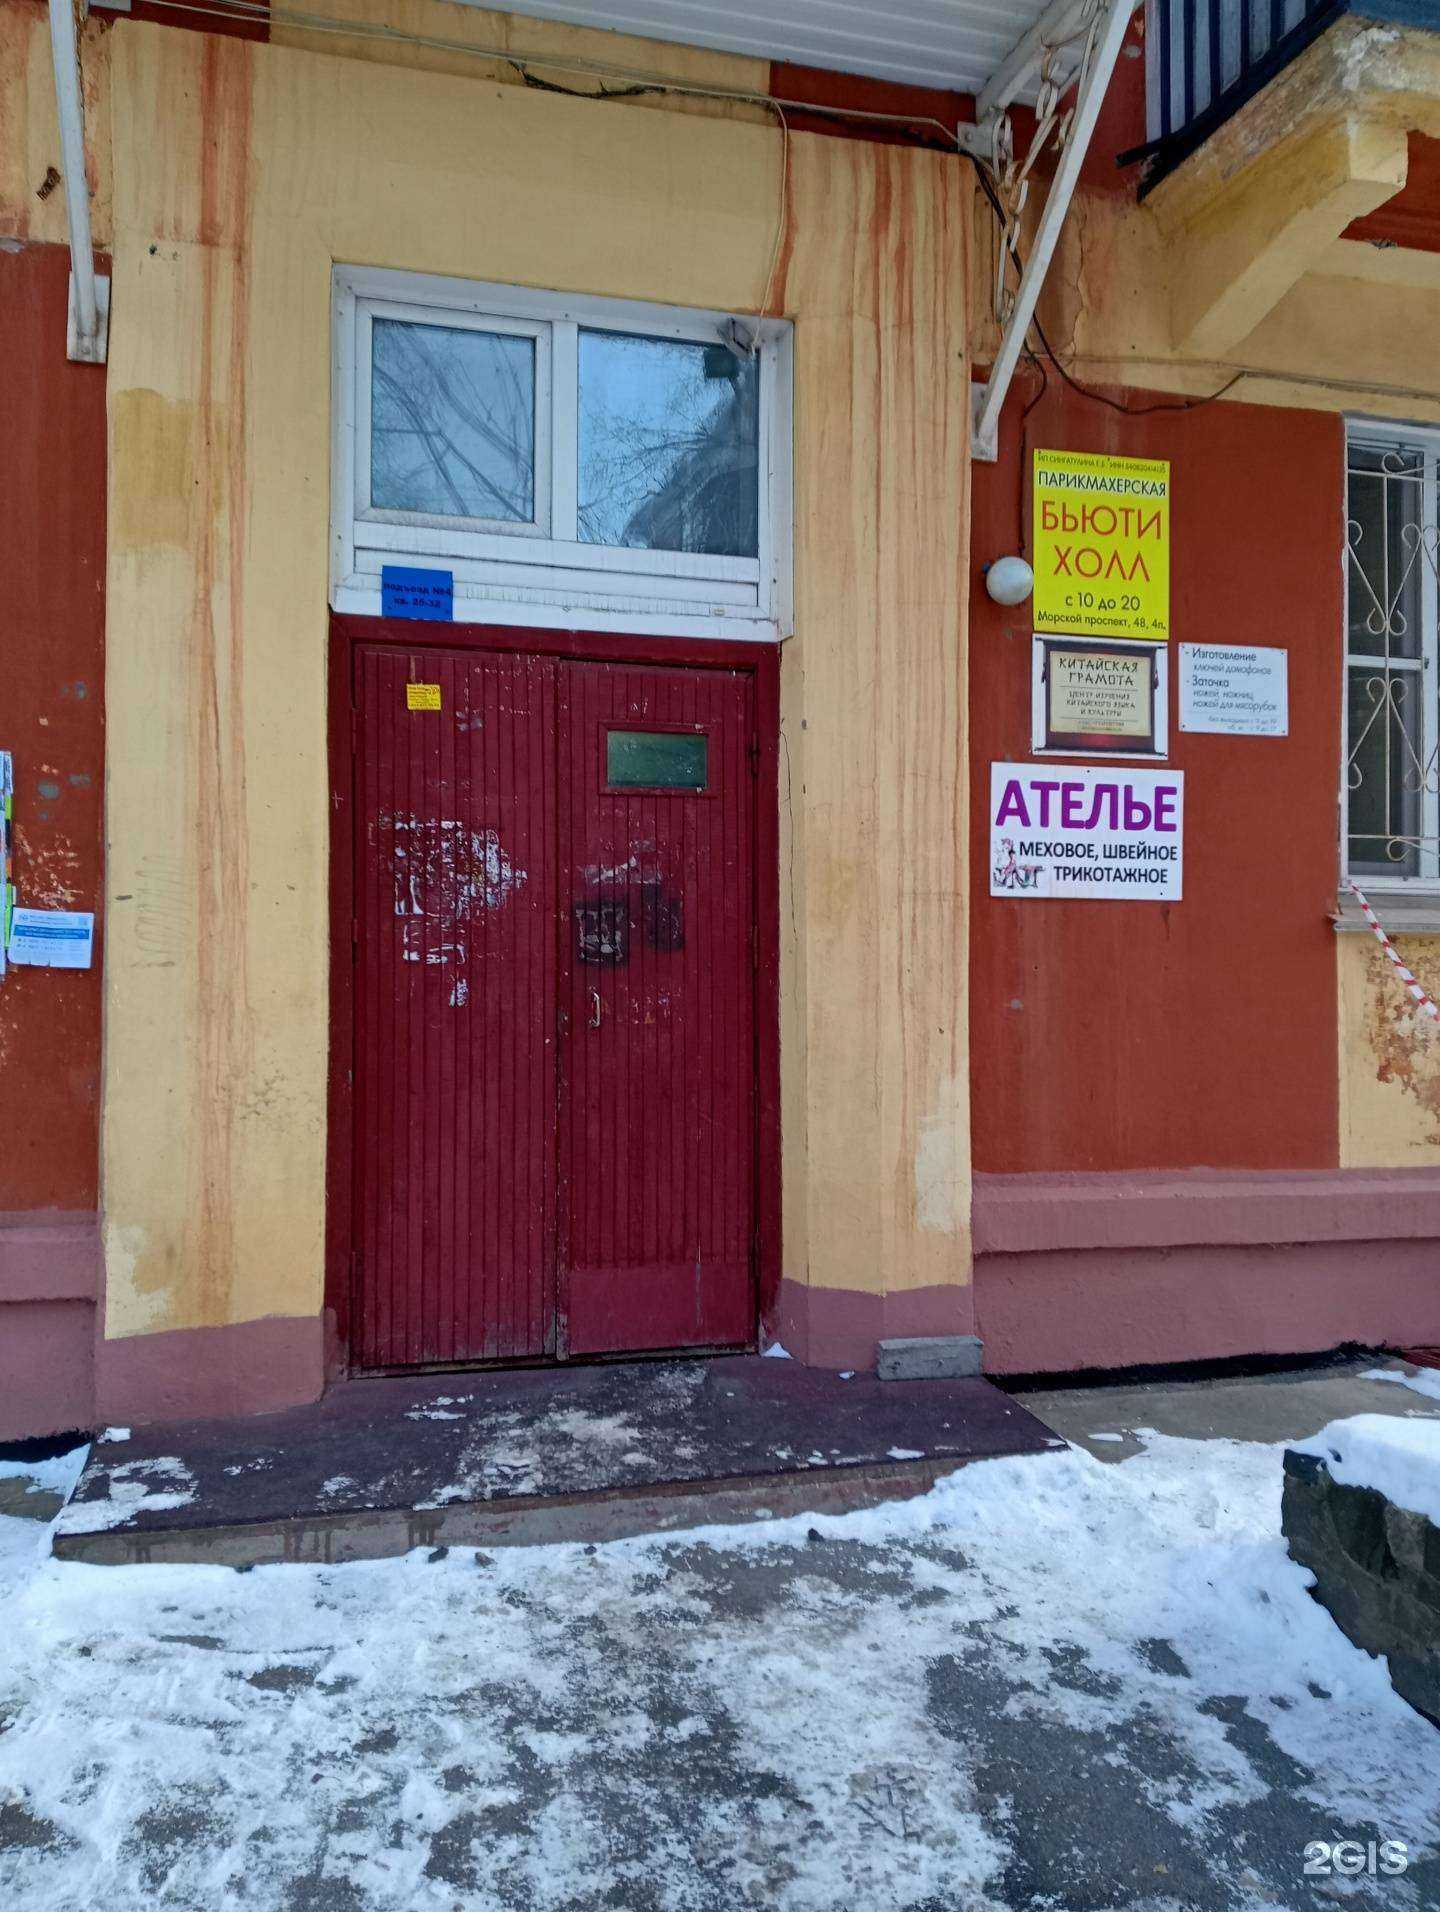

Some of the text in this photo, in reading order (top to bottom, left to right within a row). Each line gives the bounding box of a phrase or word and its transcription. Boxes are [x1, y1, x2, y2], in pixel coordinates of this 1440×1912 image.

[1038, 470, 1166, 497] ПАРИКМАХЕРСКАЯ
[1042, 500, 1161, 540] БЬЮТИ
[1053, 544, 1150, 582] ХОЛЛ
[1077, 592, 1094, 608] 10
[1098, 598, 1117, 611] до
[1121, 595, 1140, 611] 20
[1037, 610, 1082, 625] Морской
[1085, 615, 1131, 628] проспект,
[1133, 617, 1149, 630] 48,
[1192, 647, 1257, 661] Изготовление
[1059, 657, 1139, 673] КИТАЙСКАЯ
[1194, 663, 1224, 673] ключей
[1069, 672, 1134, 686] ГРАМОТА
[1192, 674, 1230, 688] Заточка
[1235, 700, 1278, 712] мясорубок
[995, 779, 1178, 832] АТЕЛЬЕ
[1019, 841, 1178, 861] МЕХОВОЕ, ШВЕЙНОЕ
[1053, 865, 1168, 884] ТРИКОТАЖНОЕ
